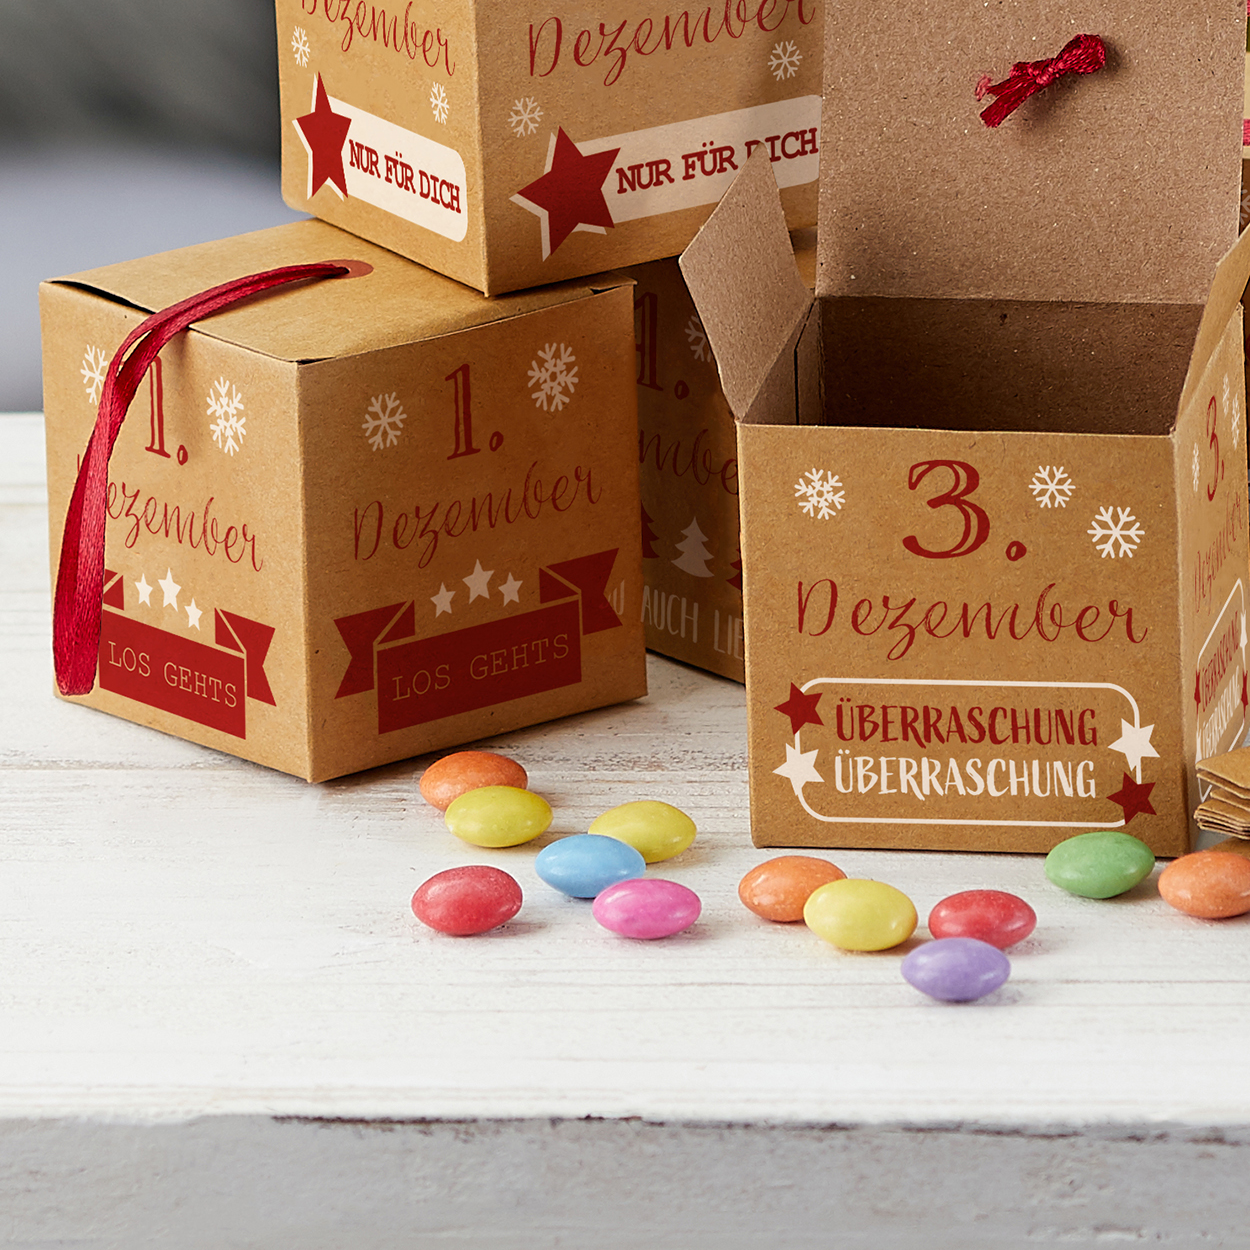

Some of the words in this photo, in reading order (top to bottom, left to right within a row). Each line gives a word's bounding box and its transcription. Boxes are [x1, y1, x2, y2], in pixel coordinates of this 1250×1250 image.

[349, 138, 381, 179] NUR
[384, 151, 416, 194] FÜR
[418, 169, 462, 214] DICH
[615, 158, 675, 195] NUR
[681, 140, 739, 181] FÜR
[145, 355, 189, 466] 1.
[444, 363, 505, 461] 1.
[1206, 395, 1225, 502] 3.
[77, 454, 264, 572] ezember
[354, 460, 603, 569] Dezember
[902, 459, 1028, 561] 3.
[640, 584, 699, 644] AUCH
[797, 578, 1148, 661] Dezember
[108, 641, 151, 677] LOS
[164, 661, 237, 708] GEHTS
[391, 664, 451, 702] LOS
[469, 634, 570, 680] GEHTS
[836, 696, 1098, 749] ÜBERRASCHUNG
[834, 749, 1097, 801] ÜBERRASCHUNG
